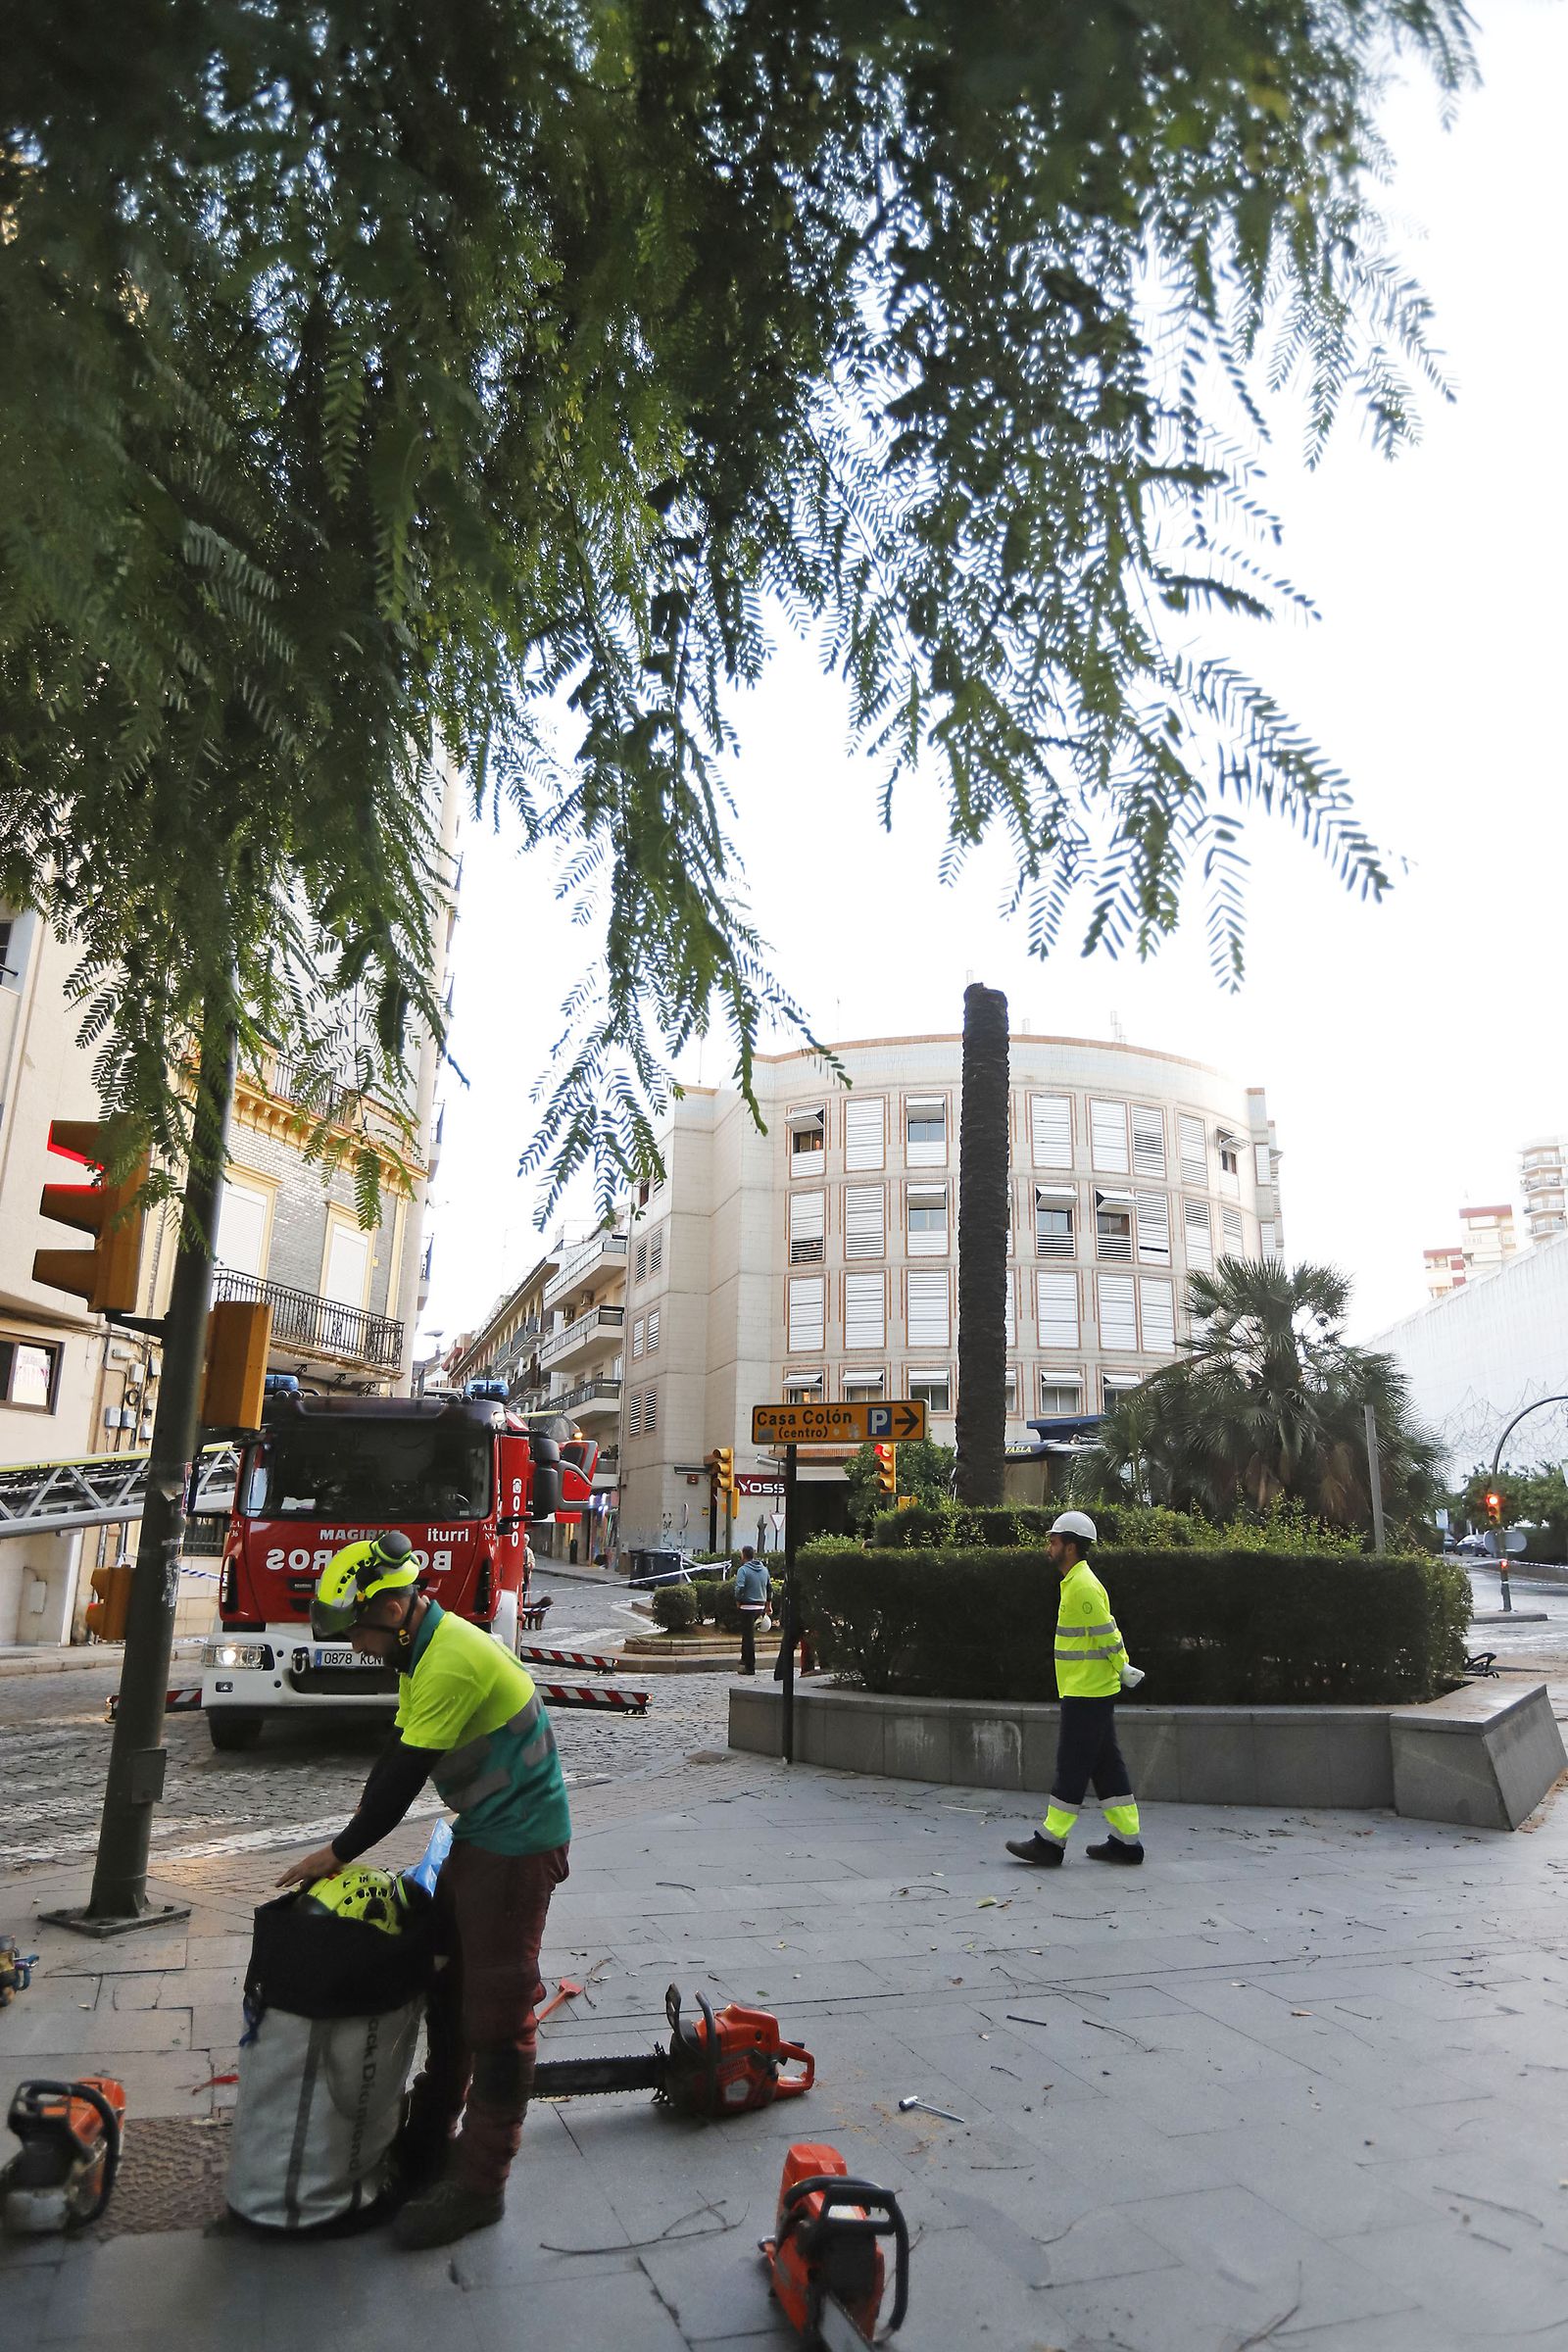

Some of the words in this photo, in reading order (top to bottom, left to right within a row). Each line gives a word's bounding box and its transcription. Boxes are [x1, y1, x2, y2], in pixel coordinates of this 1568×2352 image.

[758, 1411, 796, 1426] Casa
[803, 1408, 853, 1425] Colón
[870, 1409, 888, 1435] P
[778, 1426, 828, 1440] (centro)
[319, 1529, 401, 1541] MAGIR
[426, 1528, 469, 1543] iturri
[324, 1652, 353, 1665] 0878
